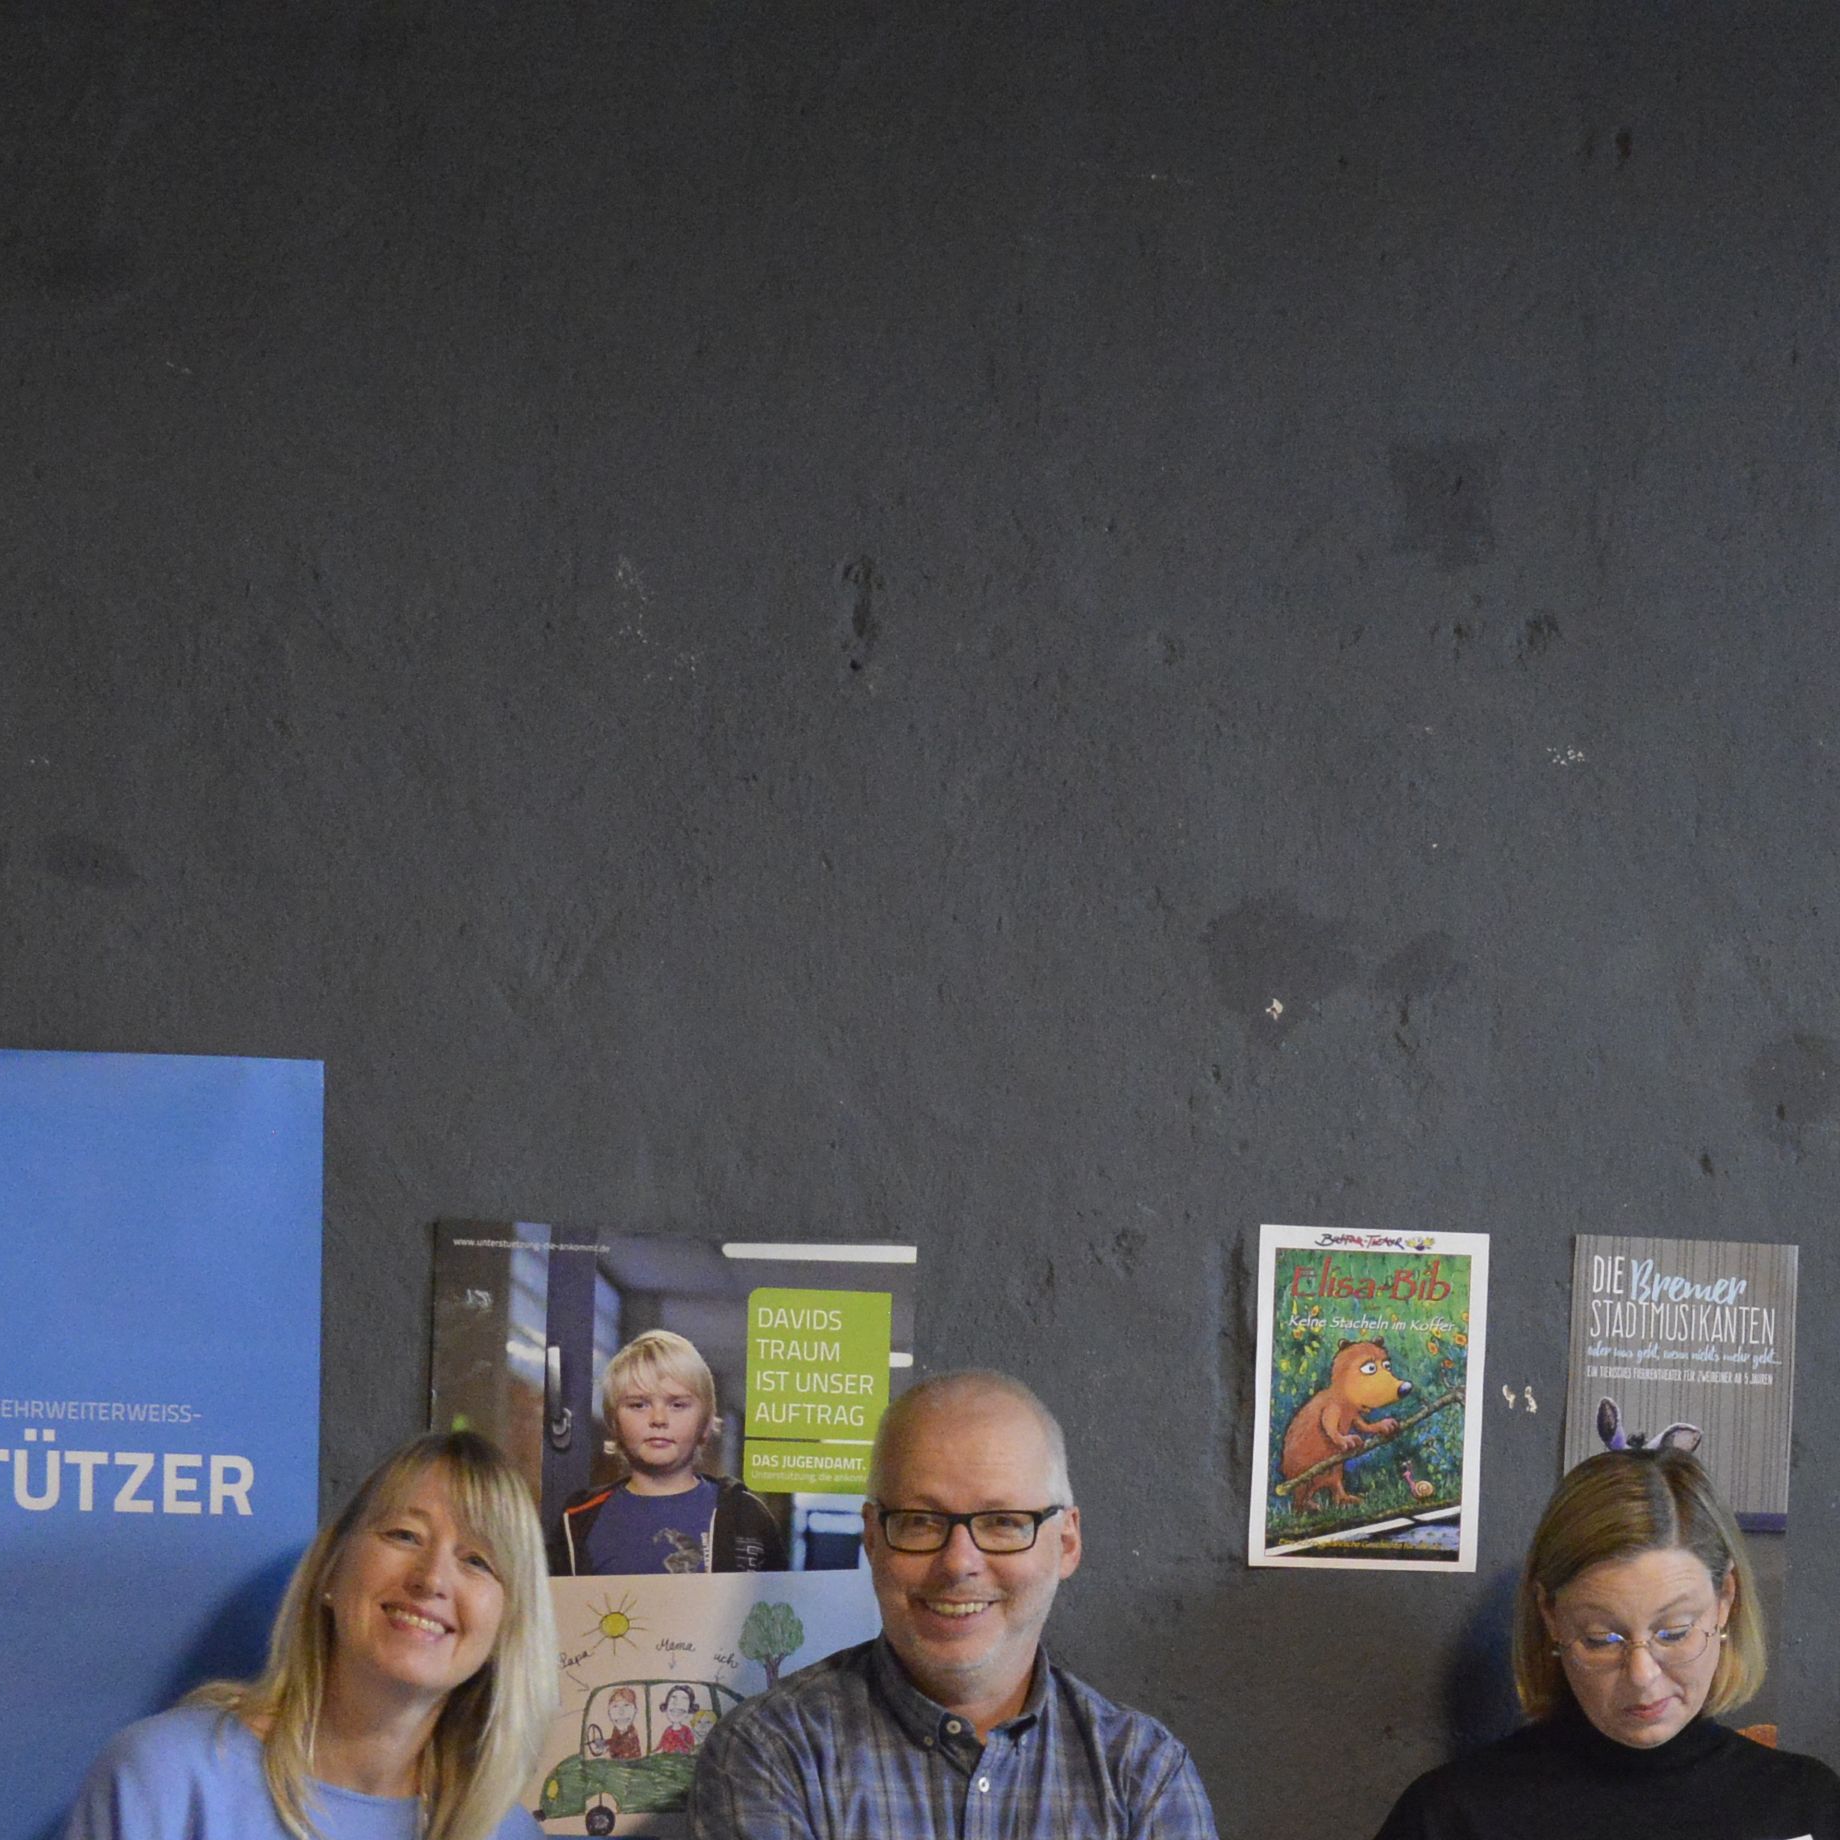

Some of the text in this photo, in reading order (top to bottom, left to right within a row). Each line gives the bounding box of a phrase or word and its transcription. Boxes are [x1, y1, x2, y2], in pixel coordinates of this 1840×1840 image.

[1631, 1259, 1747, 1305] Bremer
[758, 1308, 842, 1330] DAVIDS
[1288, 1315, 1455, 1334] Keine Stacheln im Koffer
[756, 1339, 840, 1362] TRAUM
[756, 1371, 874, 1395] IST UNSER
[755, 1402, 864, 1426] AUFTRAG
[752, 1455, 866, 1470] DAS JUGENDAMT.
[656, 1639, 695, 1652] Mama
[559, 1650, 593, 1669] Papa
